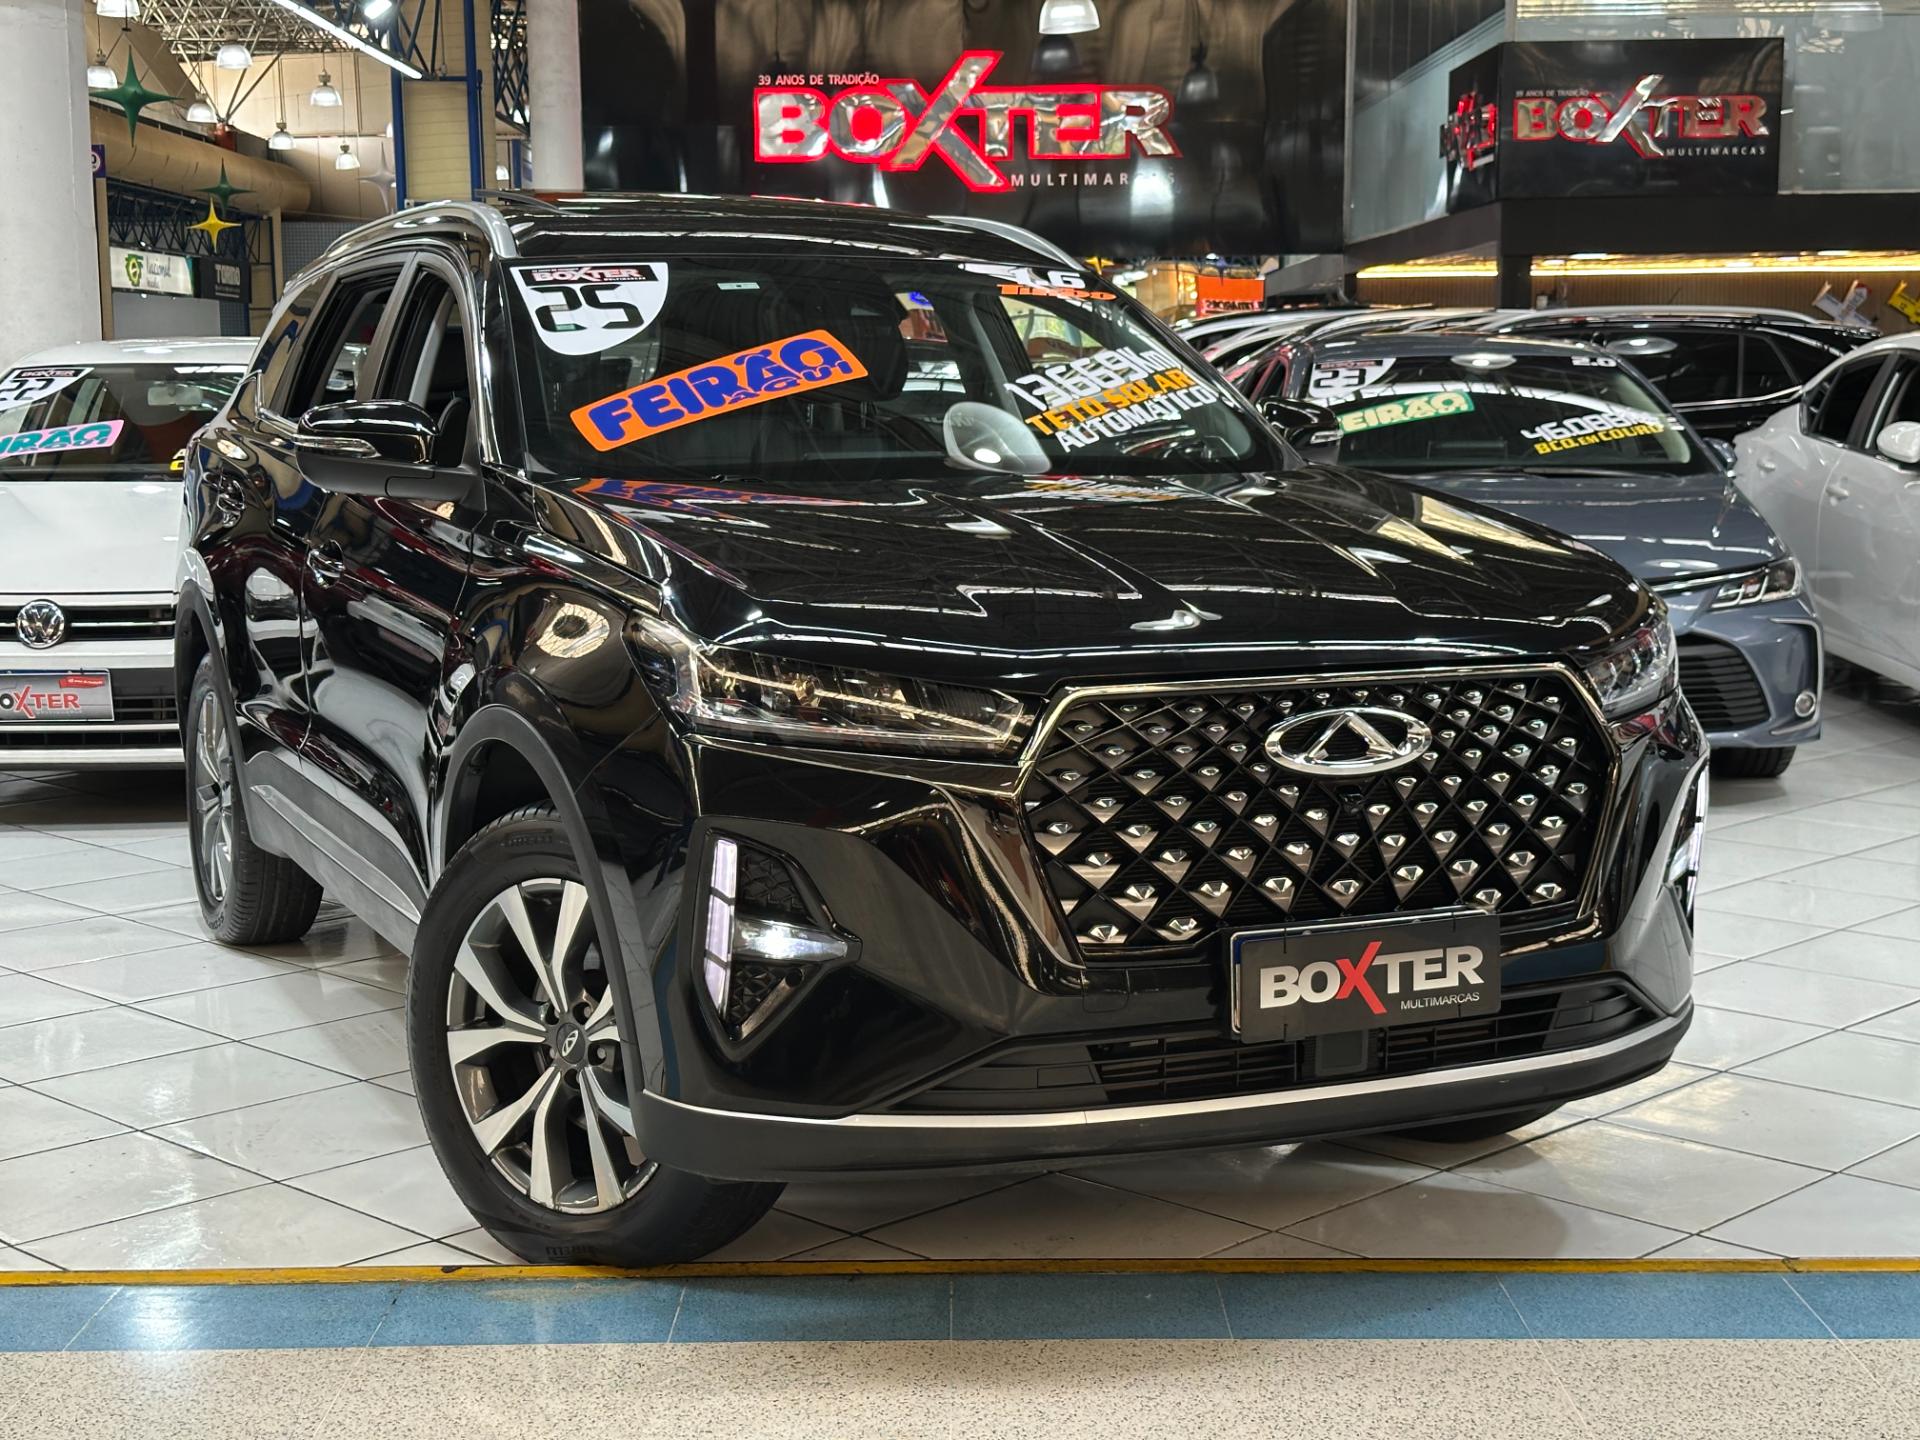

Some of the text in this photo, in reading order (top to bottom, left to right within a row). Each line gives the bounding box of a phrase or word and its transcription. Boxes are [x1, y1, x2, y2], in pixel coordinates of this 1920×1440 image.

[758, 72, 879, 86] 39 ANOS DE TRADIÇÃO
[1525, 90, 1544, 98] ANOS
[754, 50, 1183, 192] BOXTER
[1512, 74, 1769, 159] BOXTER
[1666, 147, 1766, 157] MULTIMARCAS
[1010, 173, 1175, 186] MULTIMARS
[532, 267, 641, 283] BOXTER
[1013, 267, 1086, 289] 1.6
[530, 283, 645, 333] 25
[1571, 356, 1617, 367] 2.0
[1313, 367, 1367, 389] 23
[588, 338, 842, 441] FEIRÃO
[1025, 367, 1197, 436] TETO SOLAR
[1337, 391, 1465, 432] EIRÃO
[1260, 941, 1485, 1015] BOXTER
[1400, 991, 1480, 1010] MULTIMARCAS
